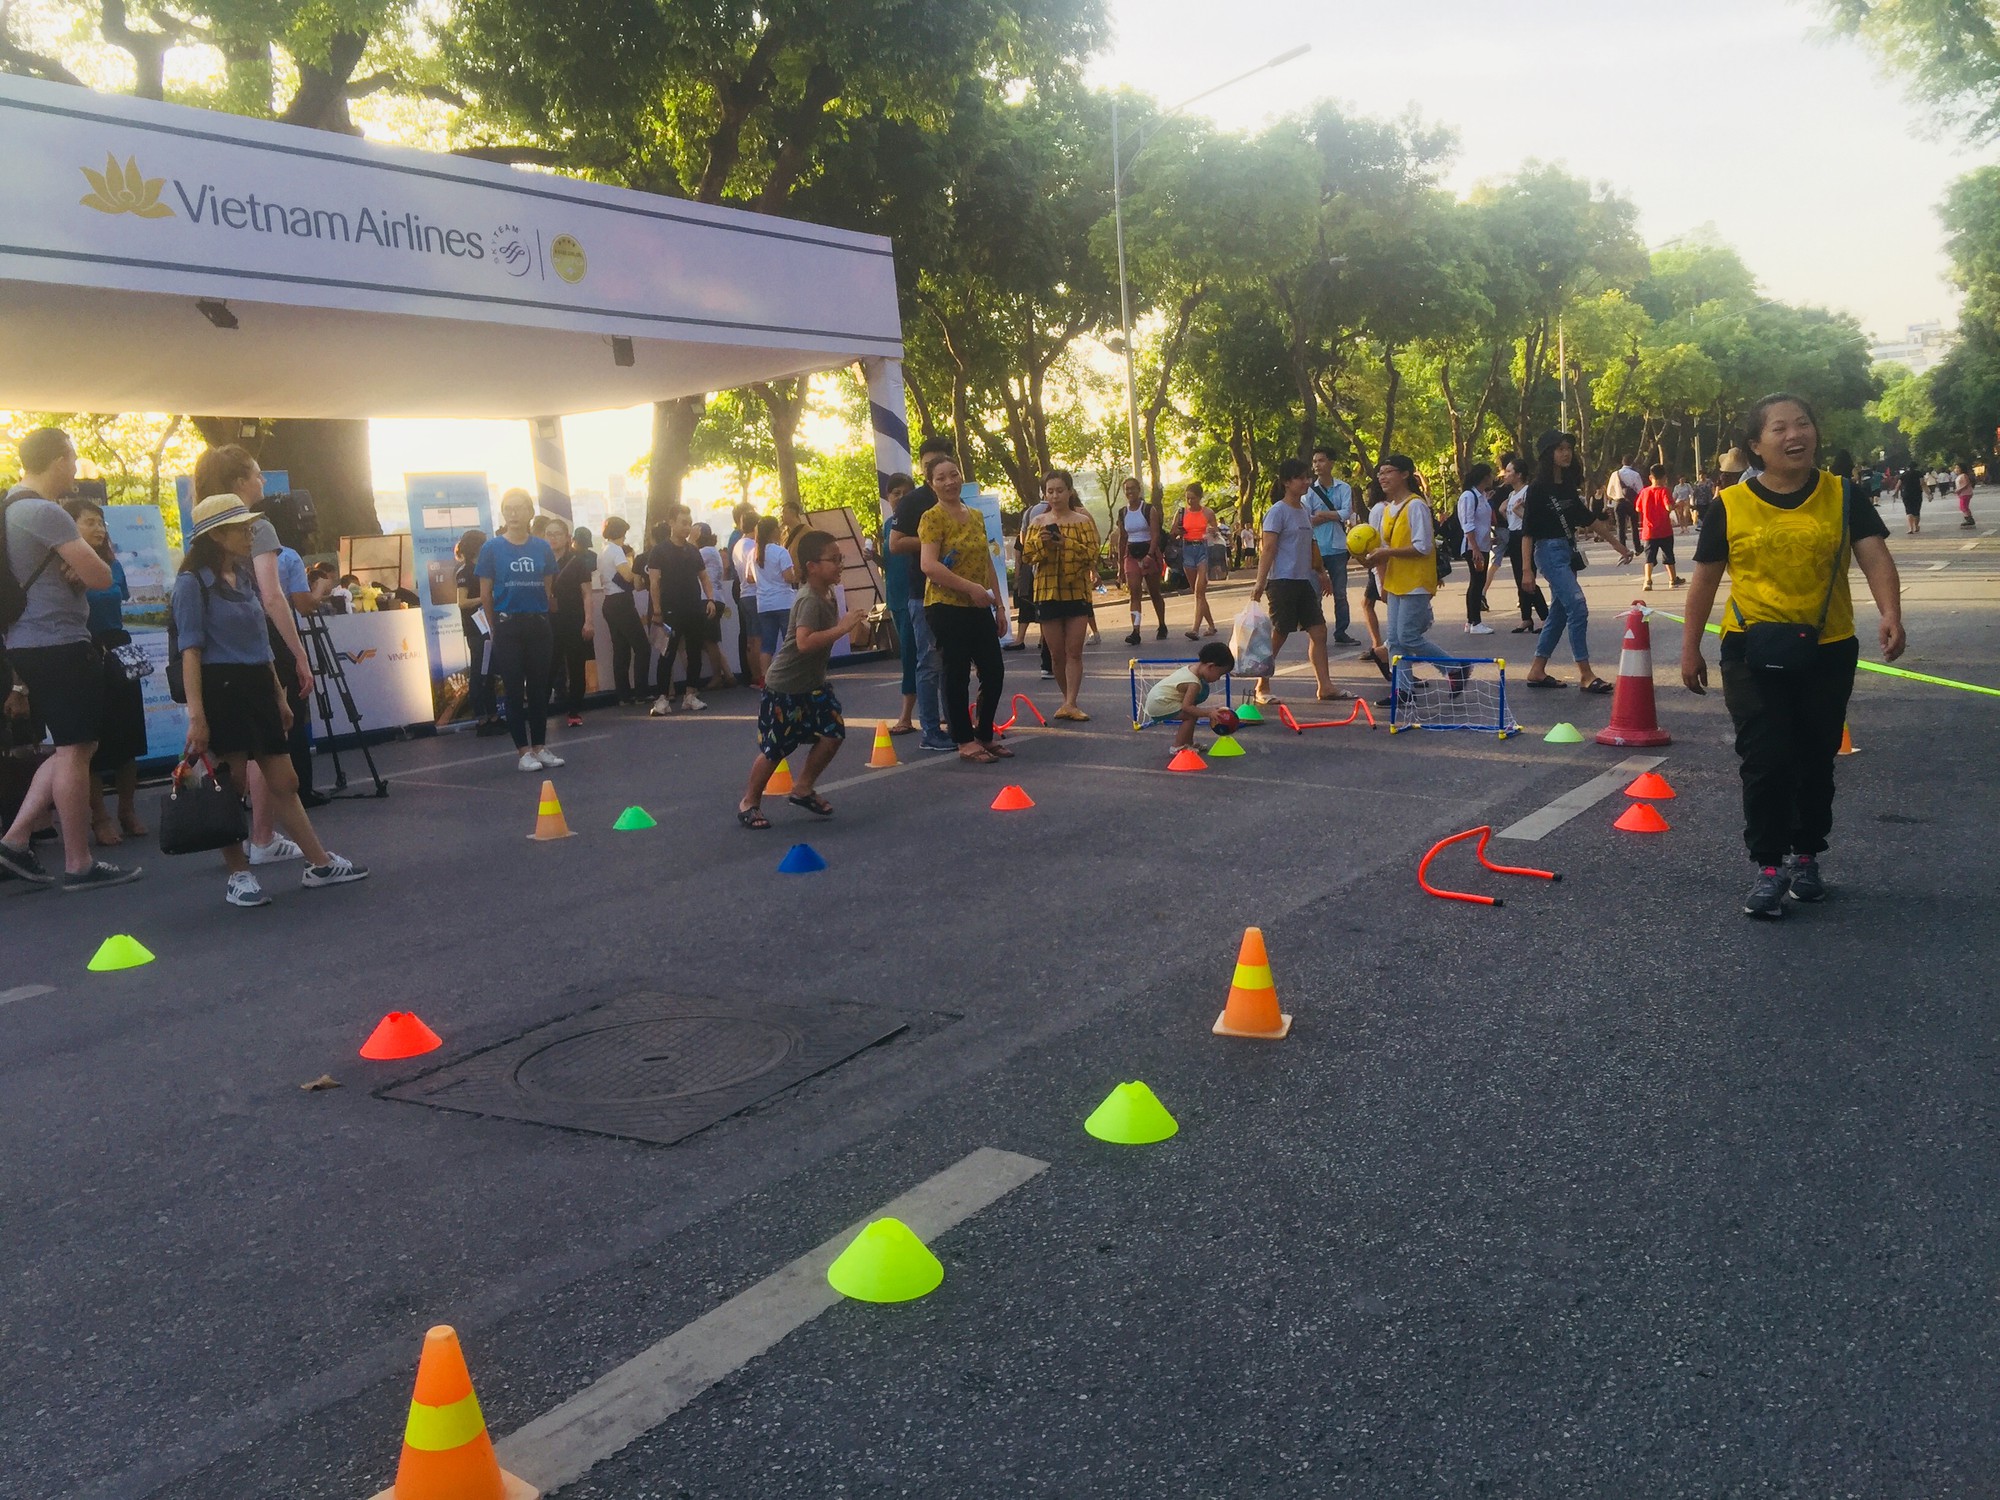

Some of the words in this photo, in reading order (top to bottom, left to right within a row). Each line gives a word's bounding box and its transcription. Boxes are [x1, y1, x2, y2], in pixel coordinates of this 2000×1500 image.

[173, 179, 350, 242] Vietnam
[355, 207, 485, 259] Airlines
[509, 556, 535, 572] citi
